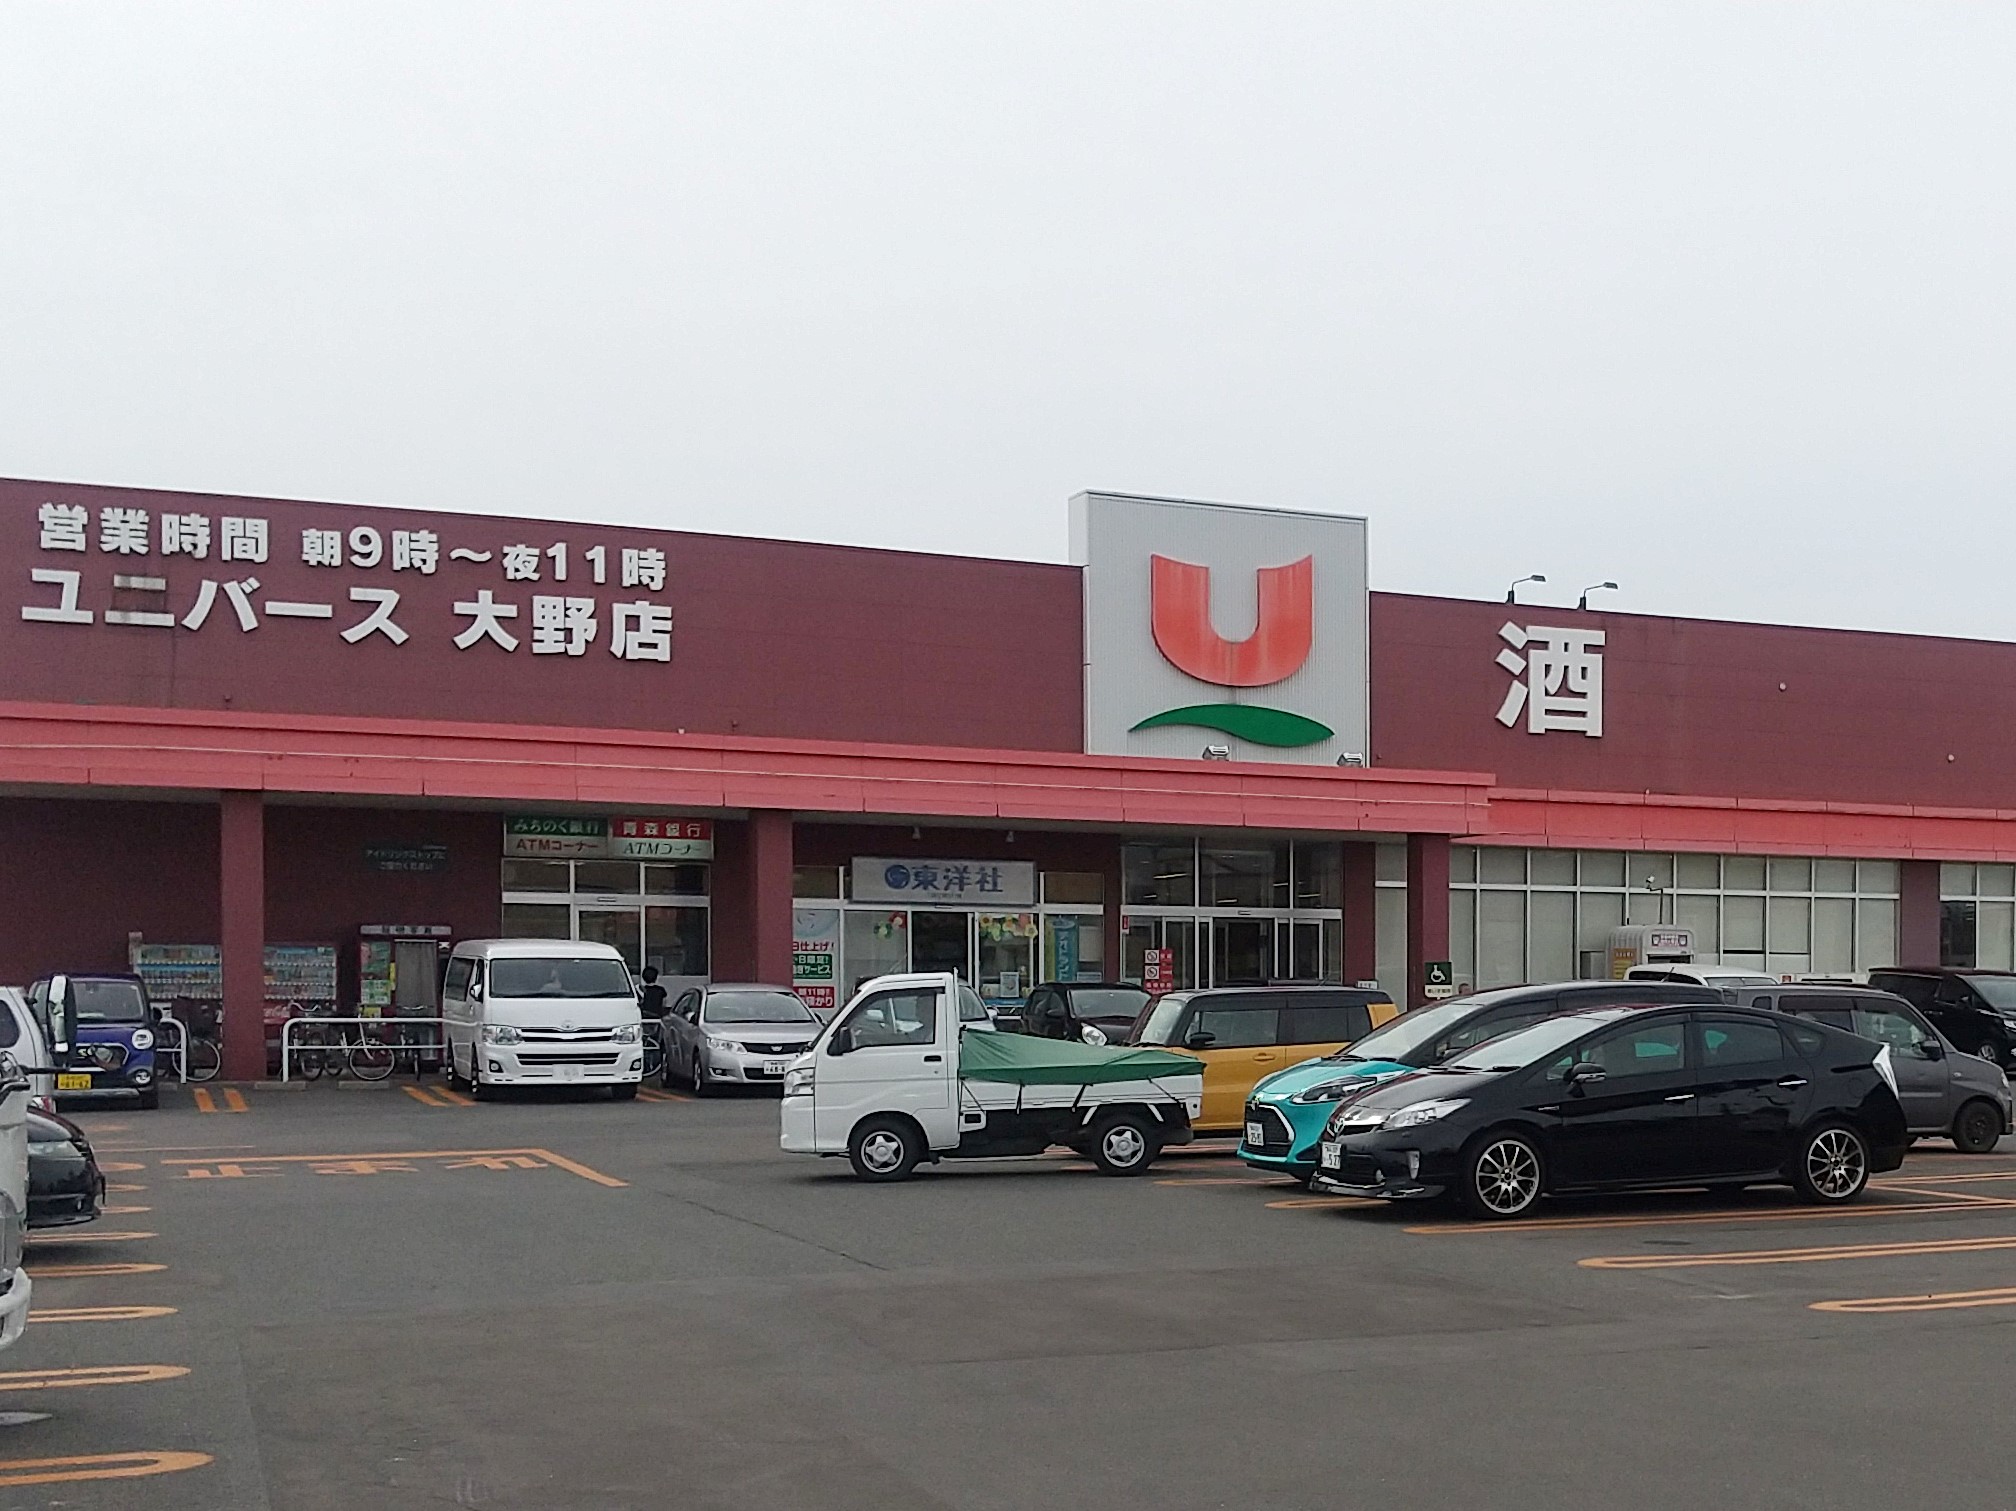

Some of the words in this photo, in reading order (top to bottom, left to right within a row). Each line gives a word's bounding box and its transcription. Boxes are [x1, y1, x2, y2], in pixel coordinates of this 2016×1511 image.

[38, 503, 268, 562] 営業時間
[22, 567, 409, 645] ユニバース
[453, 590, 673, 662] 大野店
[1151, 554, 1312, 686] U
[1496, 620, 1605, 737] 酒
[516, 837, 599, 851] ATMコーナー
[623, 821, 701, 837] 青森銀行
[623, 840, 701, 855] ATMコーナー
[912, 864, 1003, 893] 東洋社
